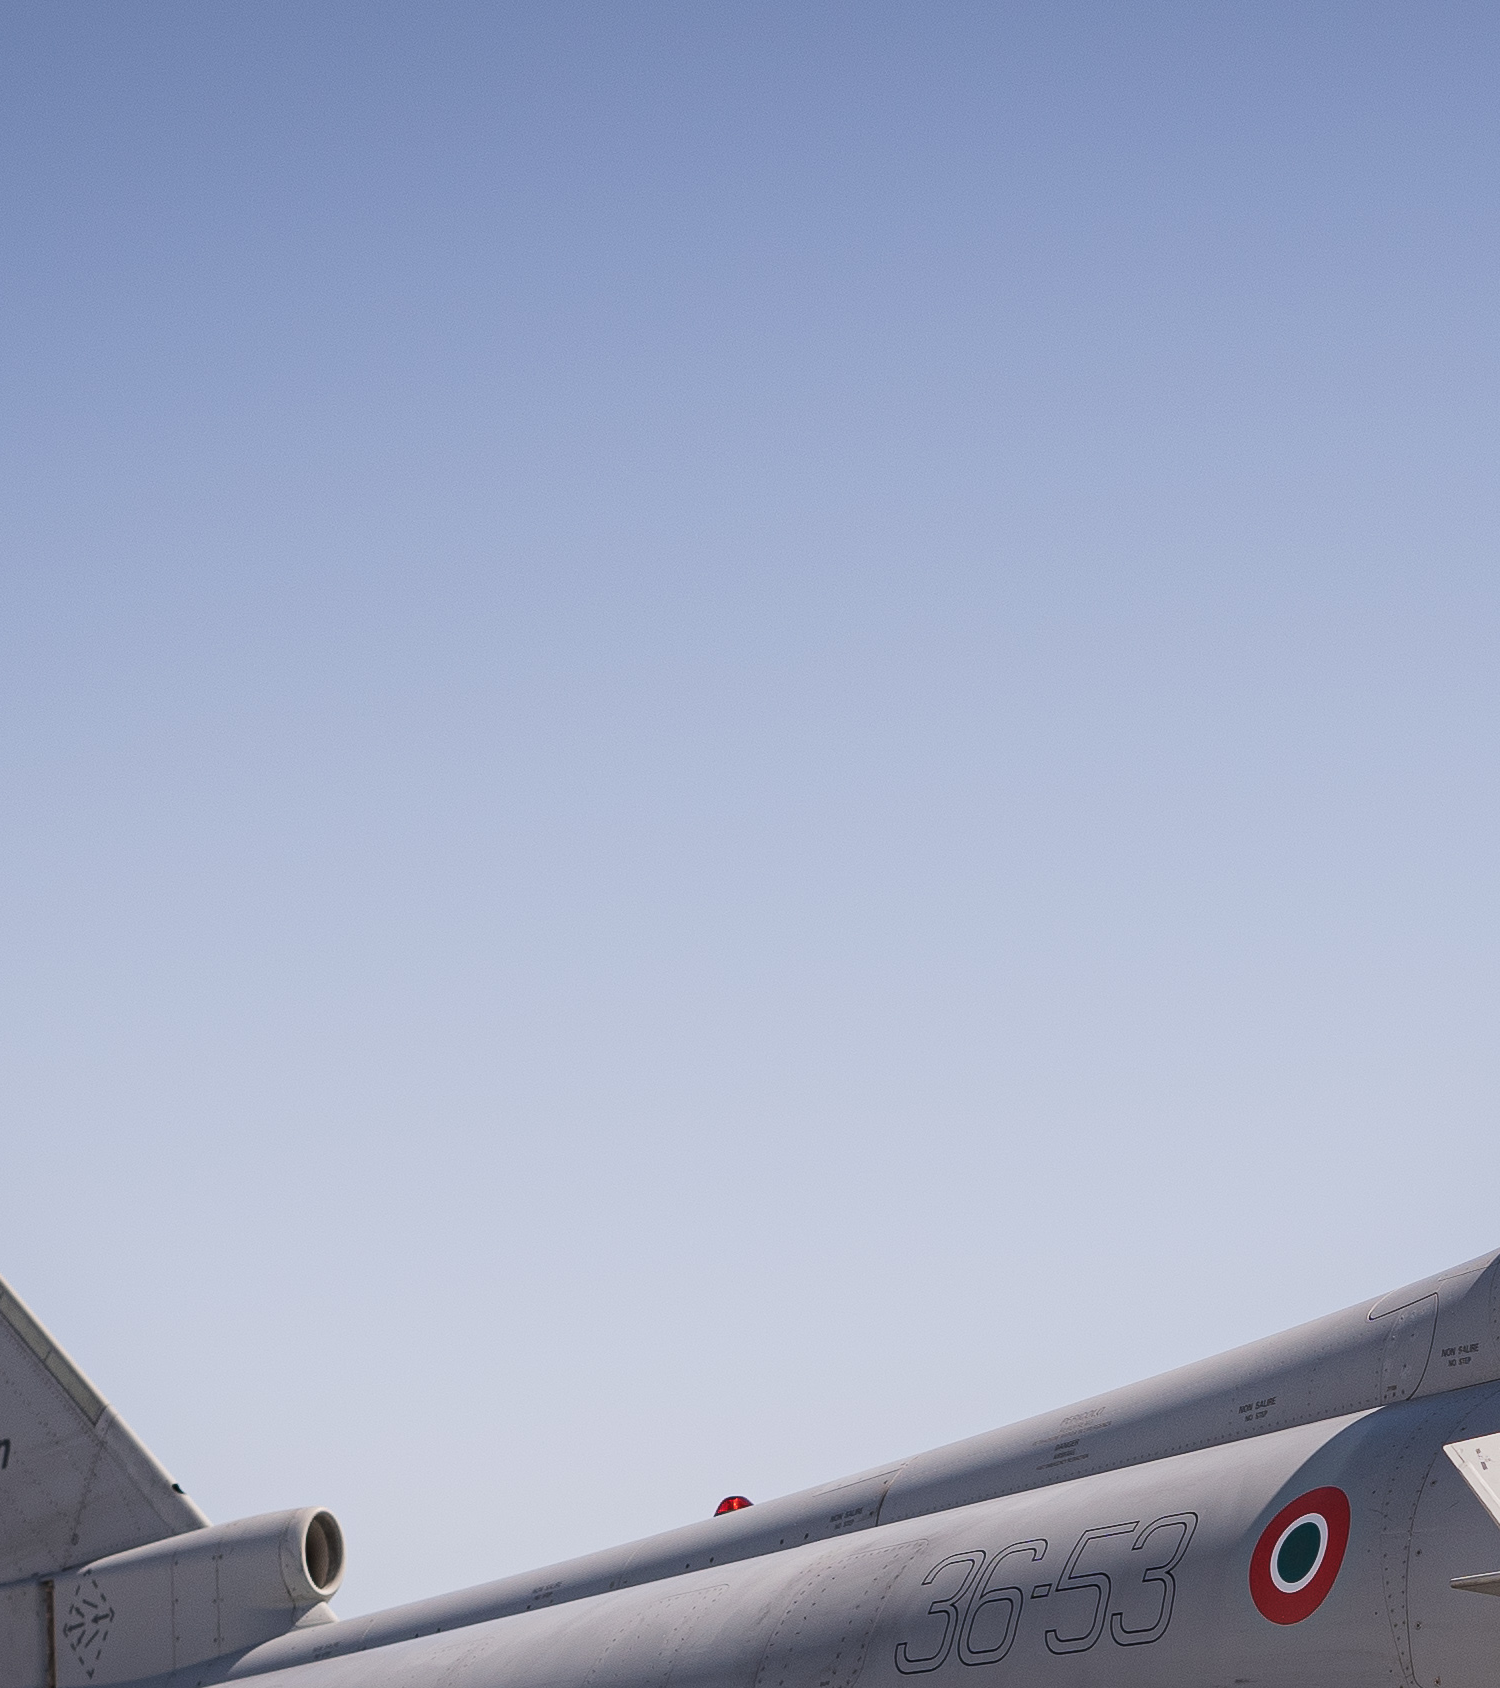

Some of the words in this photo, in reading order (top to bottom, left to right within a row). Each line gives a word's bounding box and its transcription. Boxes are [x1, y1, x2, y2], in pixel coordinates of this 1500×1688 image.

[1441, 1347, 1455, 1357] NON
[1458, 1343, 1479, 1355] SALIRE
[1448, 1359, 1456, 1367] NO
[1458, 1356, 1472, 1366] STEP
[1238, 1403, 1253, 1414] NON
[1255, 1396, 1277, 1409] SALIRE
[1244, 1414, 1253, 1422] NO
[1255, 1410, 1268, 1419] STEP
[894, 1511, 1199, 1675] 36-53
